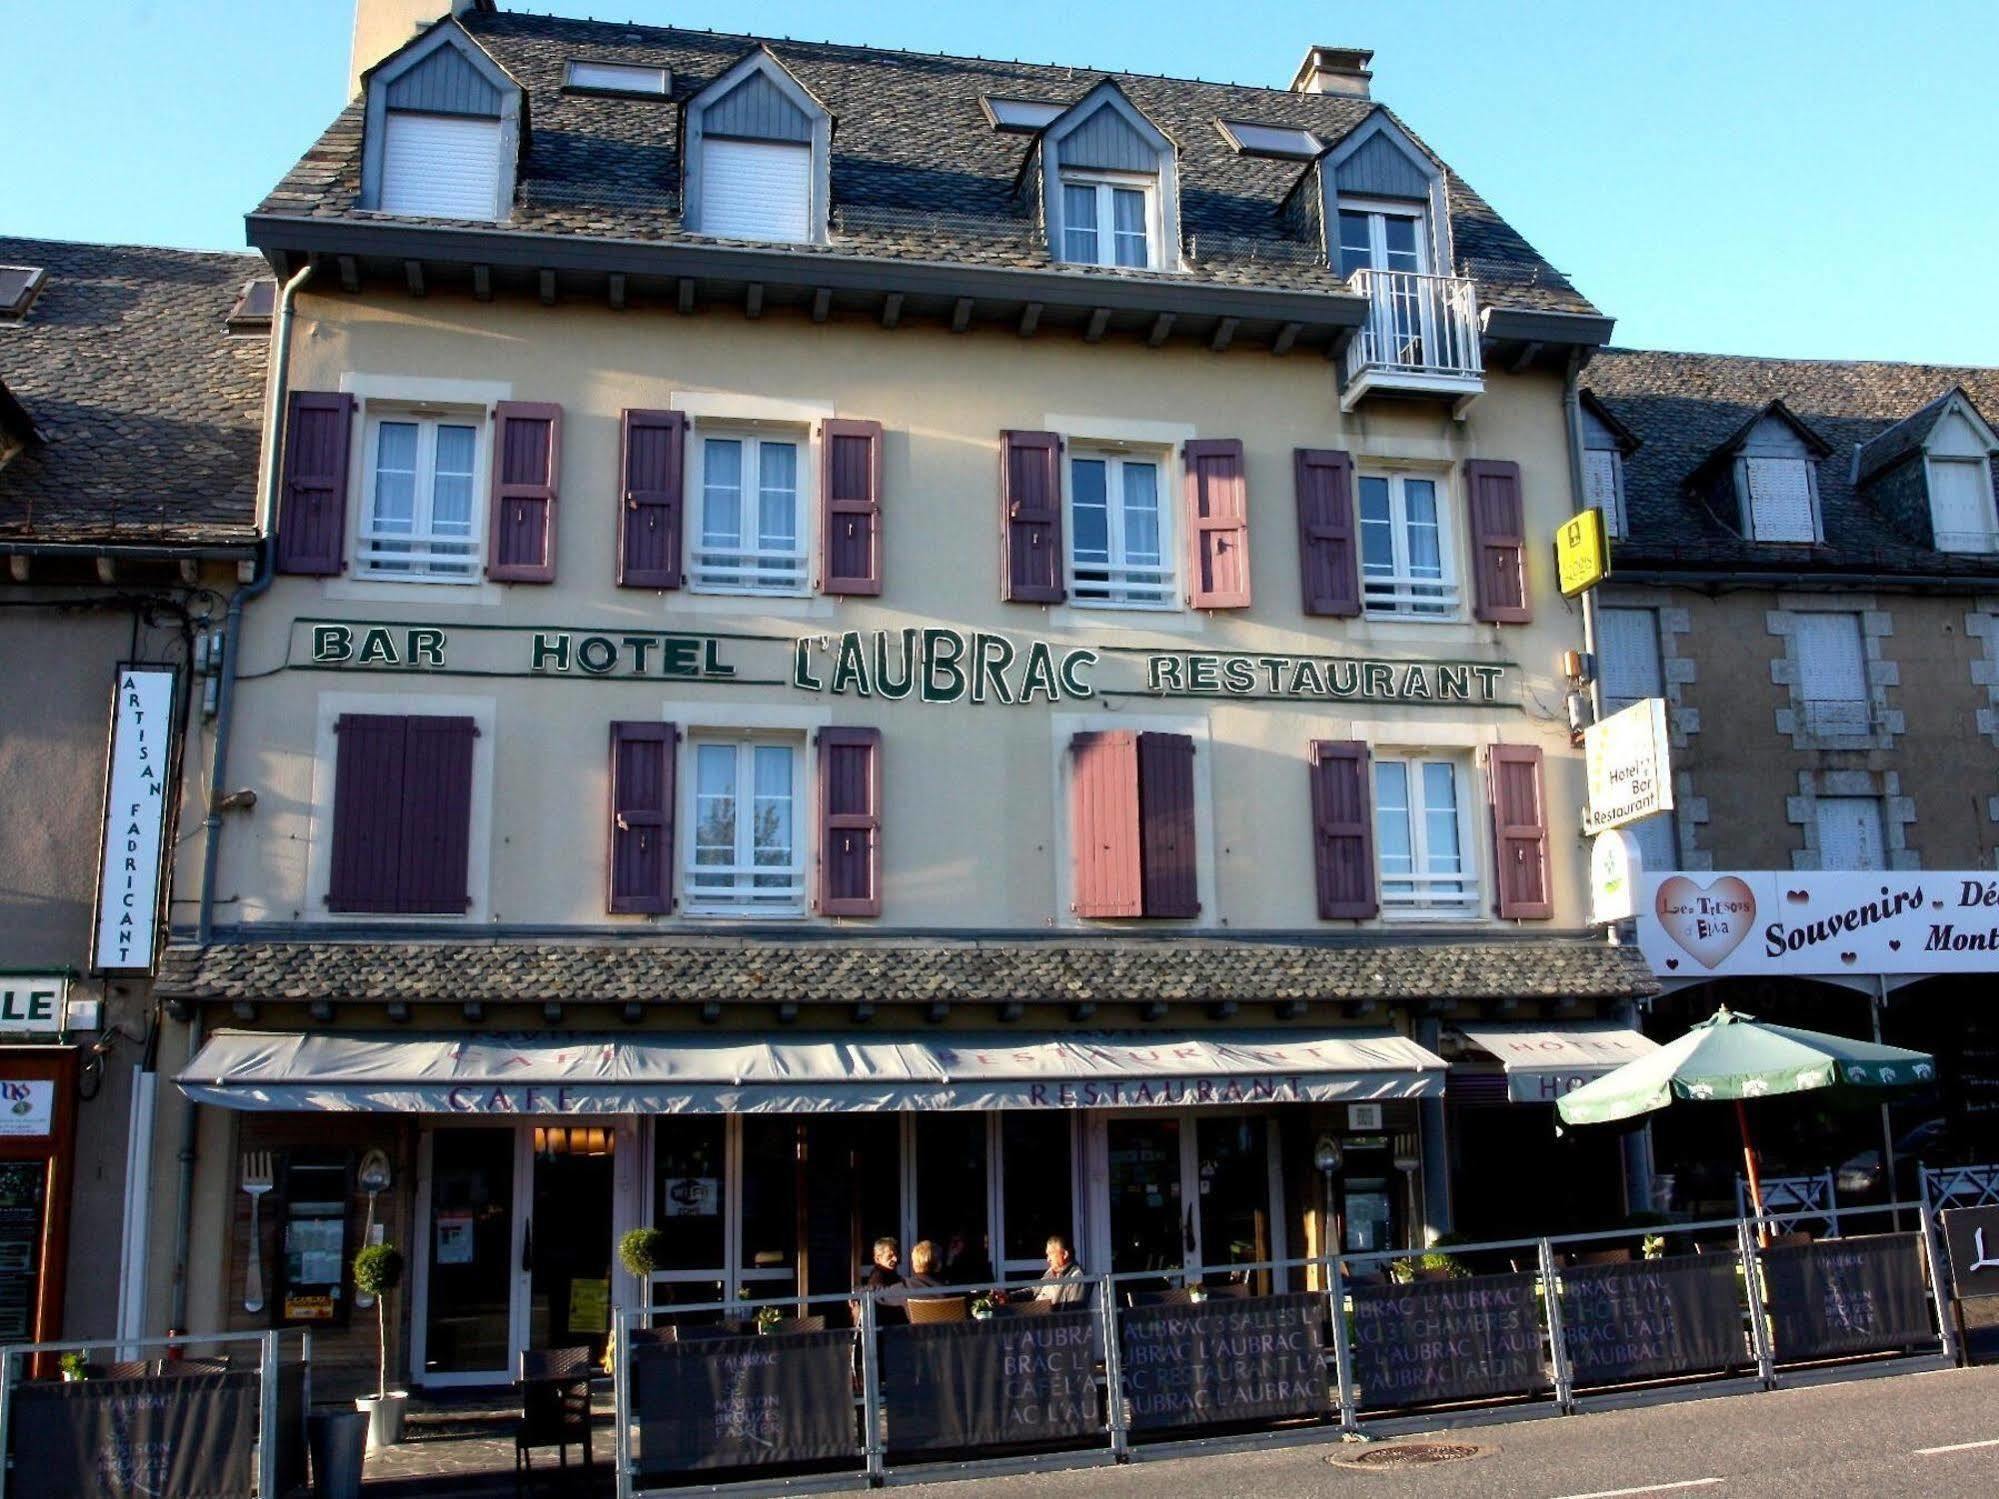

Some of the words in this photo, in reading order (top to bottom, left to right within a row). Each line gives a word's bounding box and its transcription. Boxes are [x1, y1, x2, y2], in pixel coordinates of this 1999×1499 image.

[312, 624, 447, 666] BAR
[531, 632, 737, 676] HOTEL
[794, 627, 1099, 704] L'AUBRAC
[1149, 656, 1504, 701] RESTAURANT
[123, 676, 161, 796] ARTISAN
[1594, 792, 1655, 824] Restaurant
[1958, 880, 1999, 907] Dé
[1765, 885, 1924, 958] Souvenirs
[2, 991, 55, 1020] LE
[1031, 1077, 1302, 1107] RESTAURANT
[1540, 1074, 1602, 1099] HO
[1229, 1306, 1297, 1331] SALLES
[1199, 1330, 1303, 1359] L'AUBRAC
[1004, 1352, 1063, 1376] BRAC
